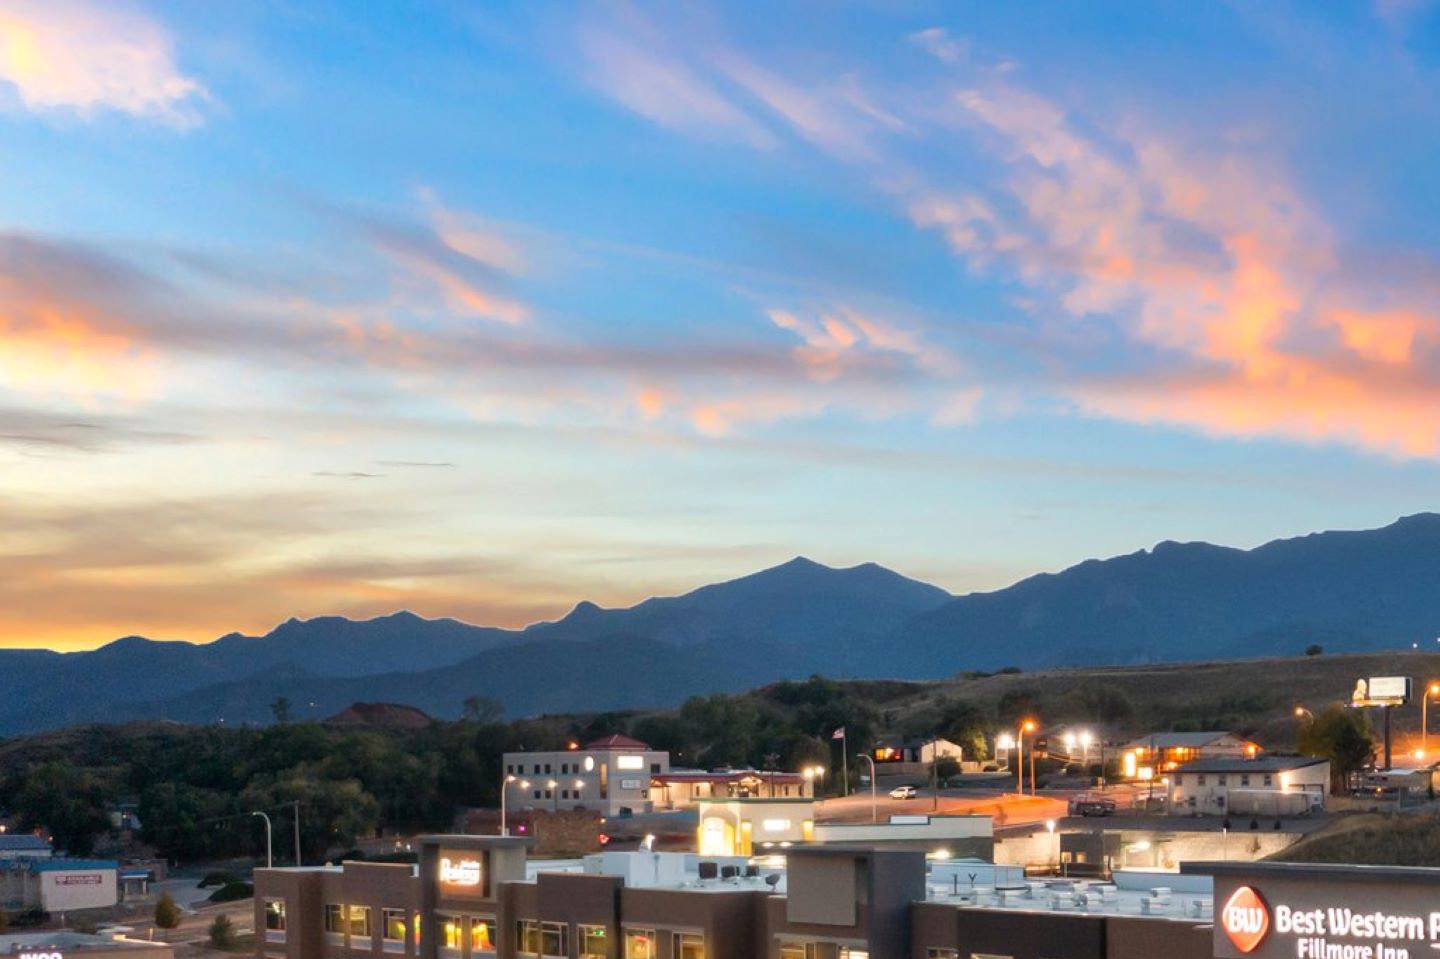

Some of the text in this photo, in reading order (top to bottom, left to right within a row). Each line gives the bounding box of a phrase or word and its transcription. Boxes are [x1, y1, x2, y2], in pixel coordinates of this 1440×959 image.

[1229, 907, 1262, 933] BW
[1276, 905, 1325, 936] Best
[1329, 908, 1425, 940] Western
